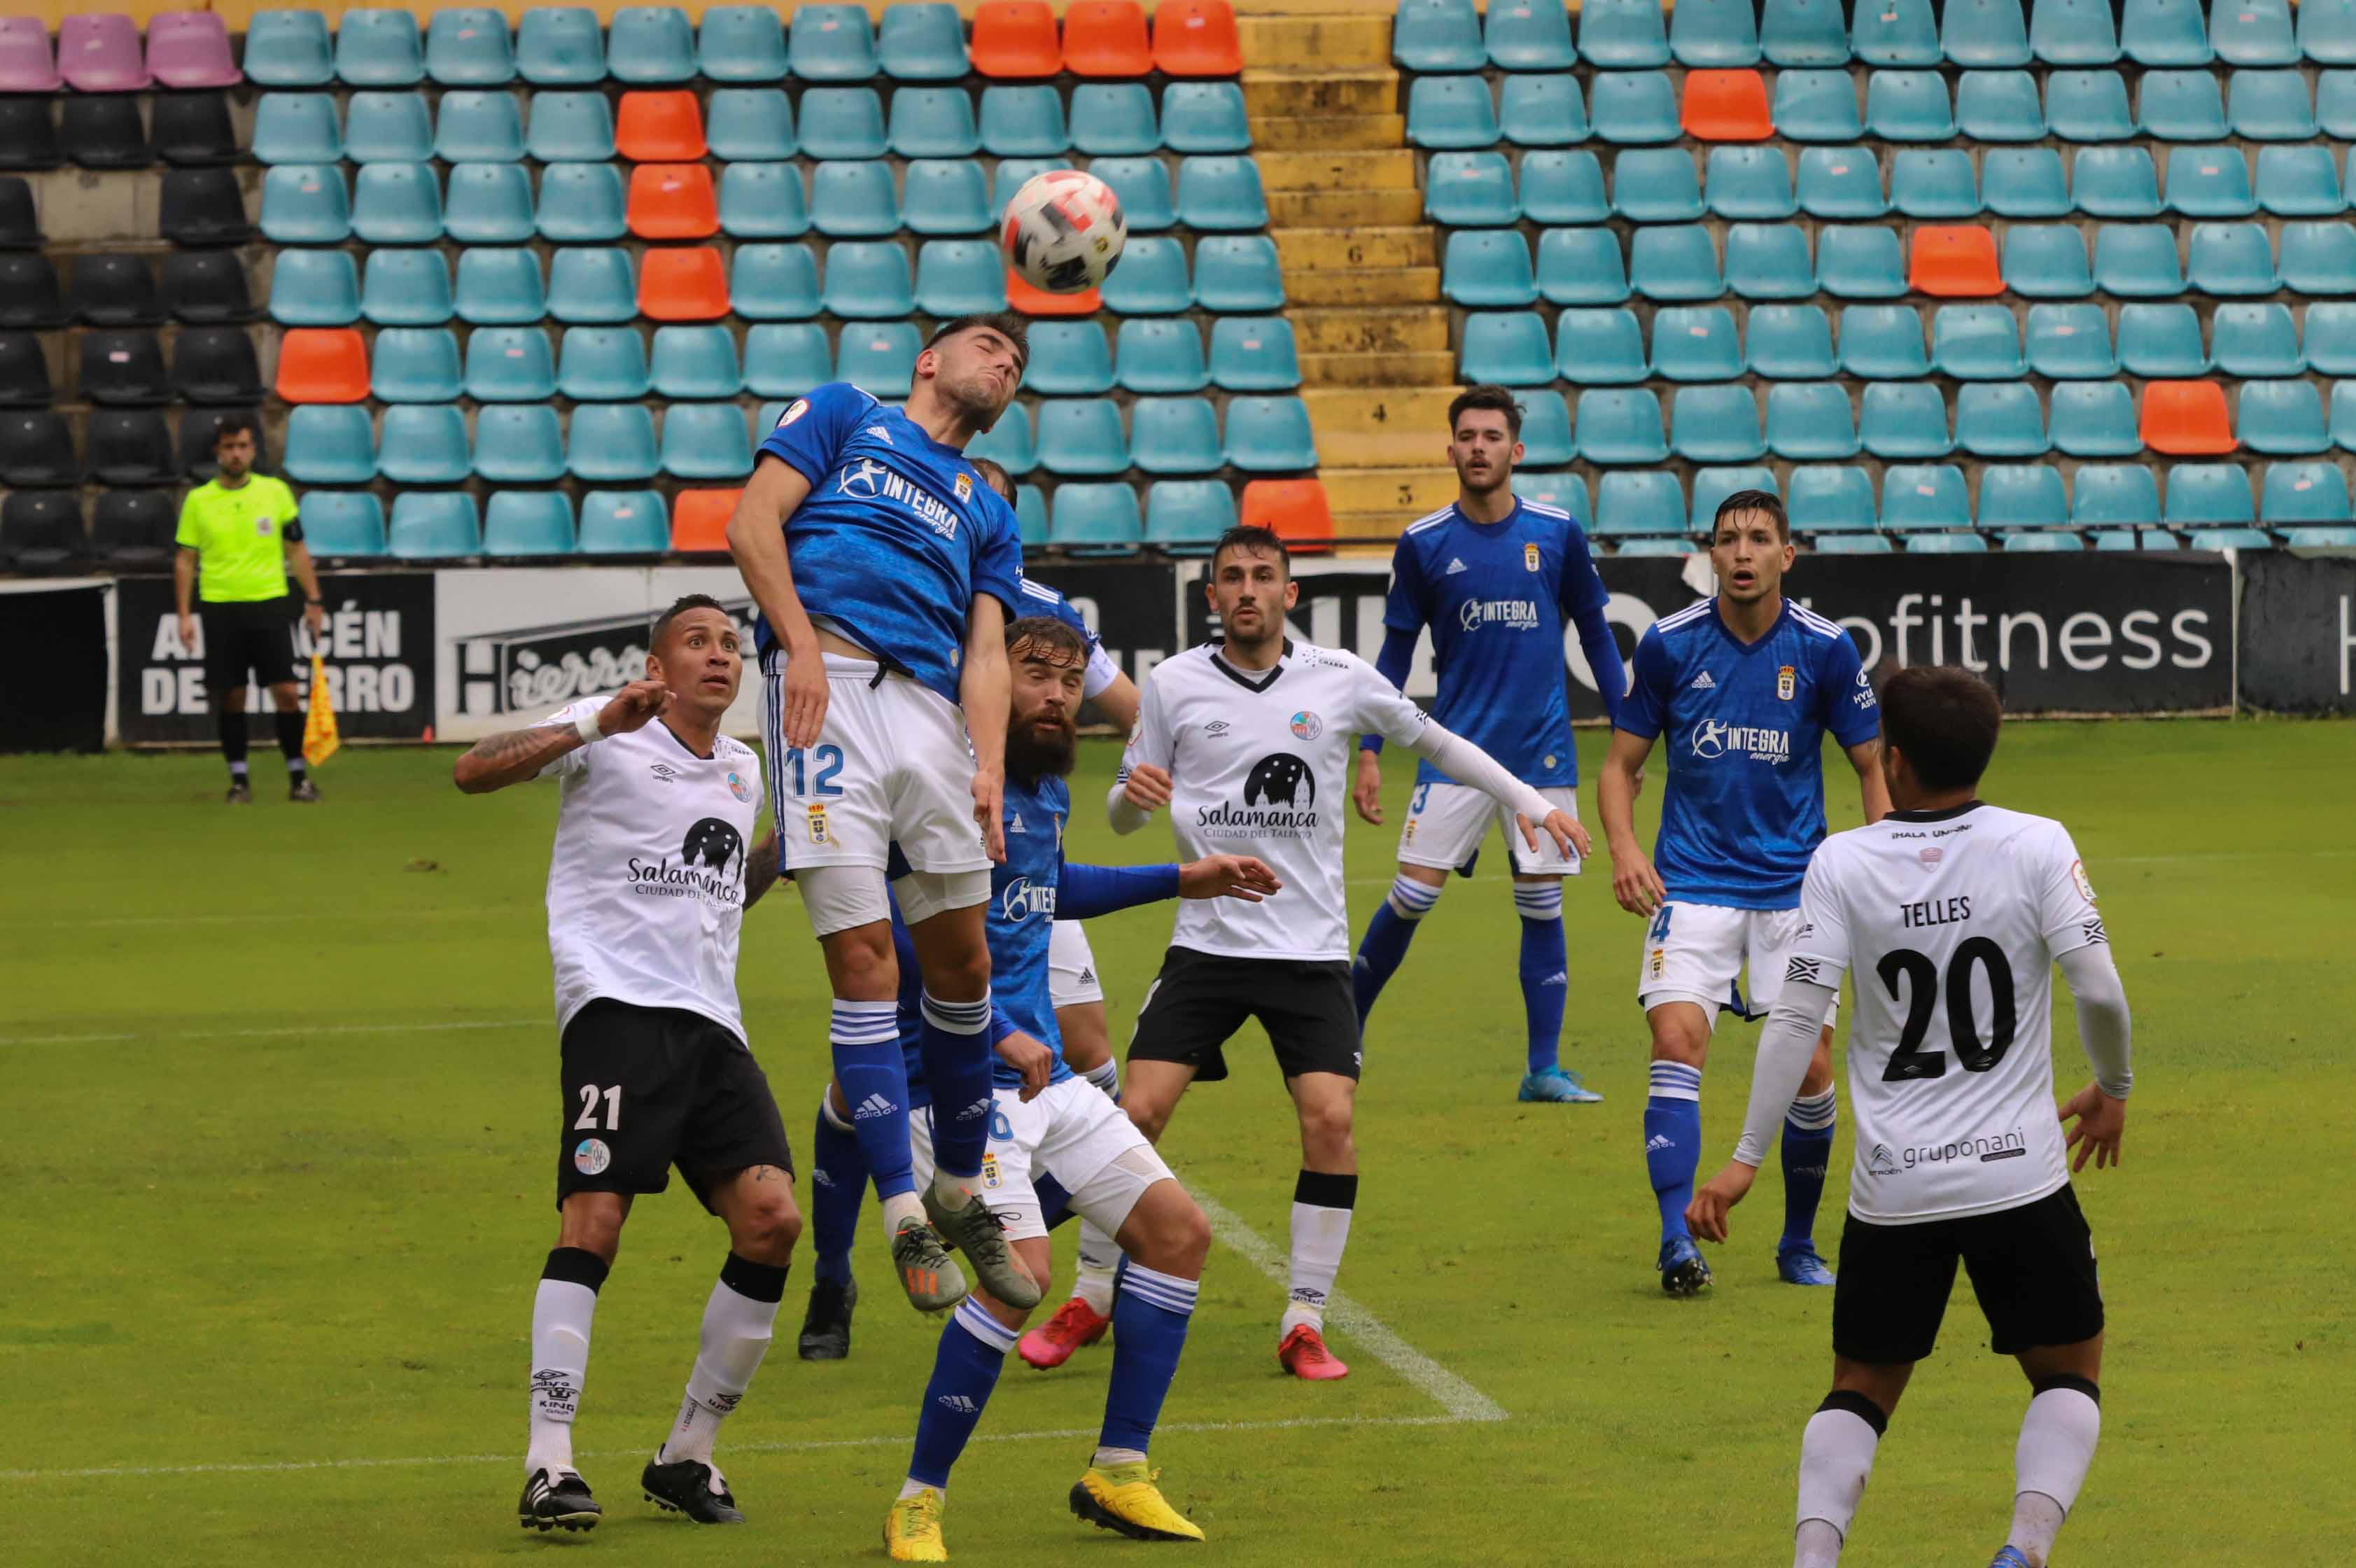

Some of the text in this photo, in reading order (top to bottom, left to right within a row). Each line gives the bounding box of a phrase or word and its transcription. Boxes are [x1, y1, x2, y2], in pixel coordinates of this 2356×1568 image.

[1347, 245, 1363, 264] 6
[1372, 402, 1387, 423] 4
[883, 471, 958, 533] INTEGRA
[152, 599, 400, 661] ACÉN
[1483, 601, 1538, 622] INTEGRA
[1801, 593, 2213, 671] ofitness
[141, 667, 209, 715] DE
[1727, 727, 1790, 754] INTEGRA
[784, 744, 844, 797] 12
[1198, 800, 1320, 828] Salamanca
[627, 858, 741, 905] Salamanca
[1651, 905, 1674, 945] 4
[1900, 895, 1971, 928] TELLES
[1876, 936, 2017, 1082] 20
[574, 1084, 622, 1131] 21
[854, 1104, 898, 1120] adidas
[1903, 1126, 2026, 1169] gruponani
[540, 1401, 575, 1412] KING
